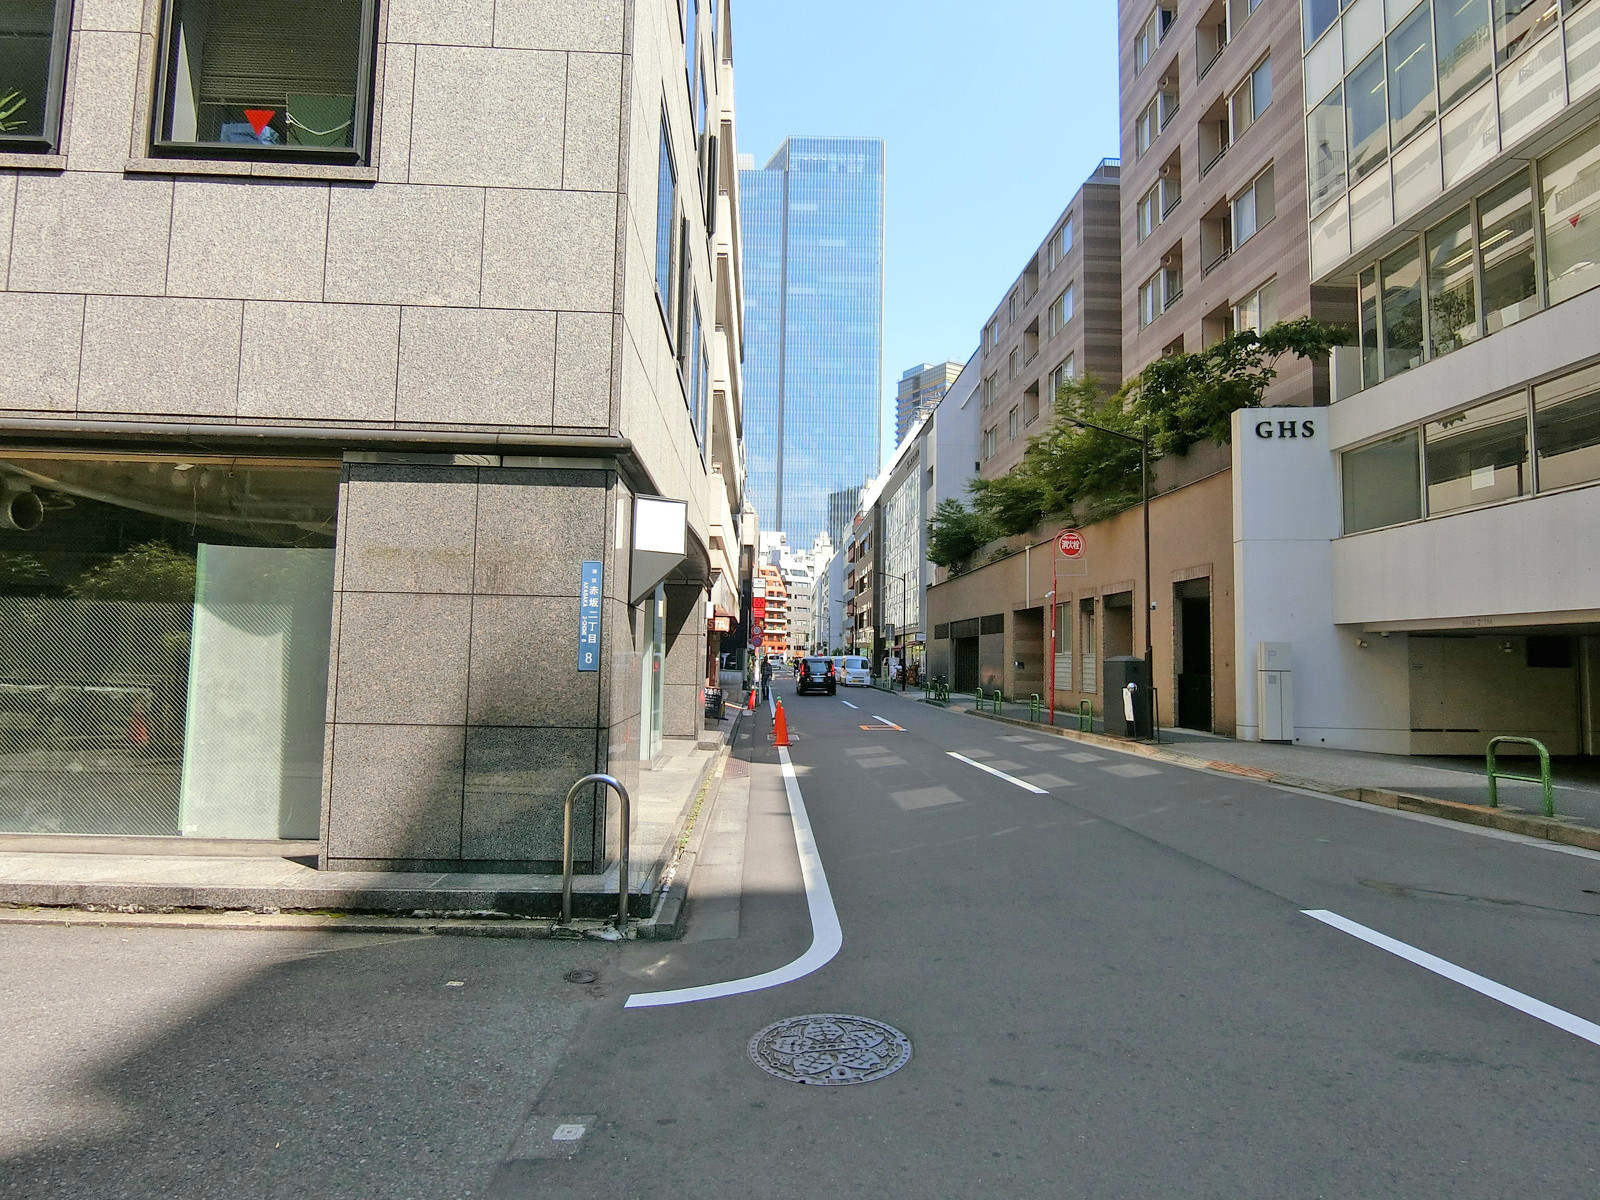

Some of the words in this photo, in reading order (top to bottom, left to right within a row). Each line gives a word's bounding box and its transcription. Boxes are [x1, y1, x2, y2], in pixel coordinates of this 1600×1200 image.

[1255, 420, 1315, 438] GHS
[1062, 540, 1080, 549] 消火栓
[588, 586, 599, 643] 赤坂二丁目
[585, 652, 592, 664] 8
[1267, 650, 1277, 662] P
